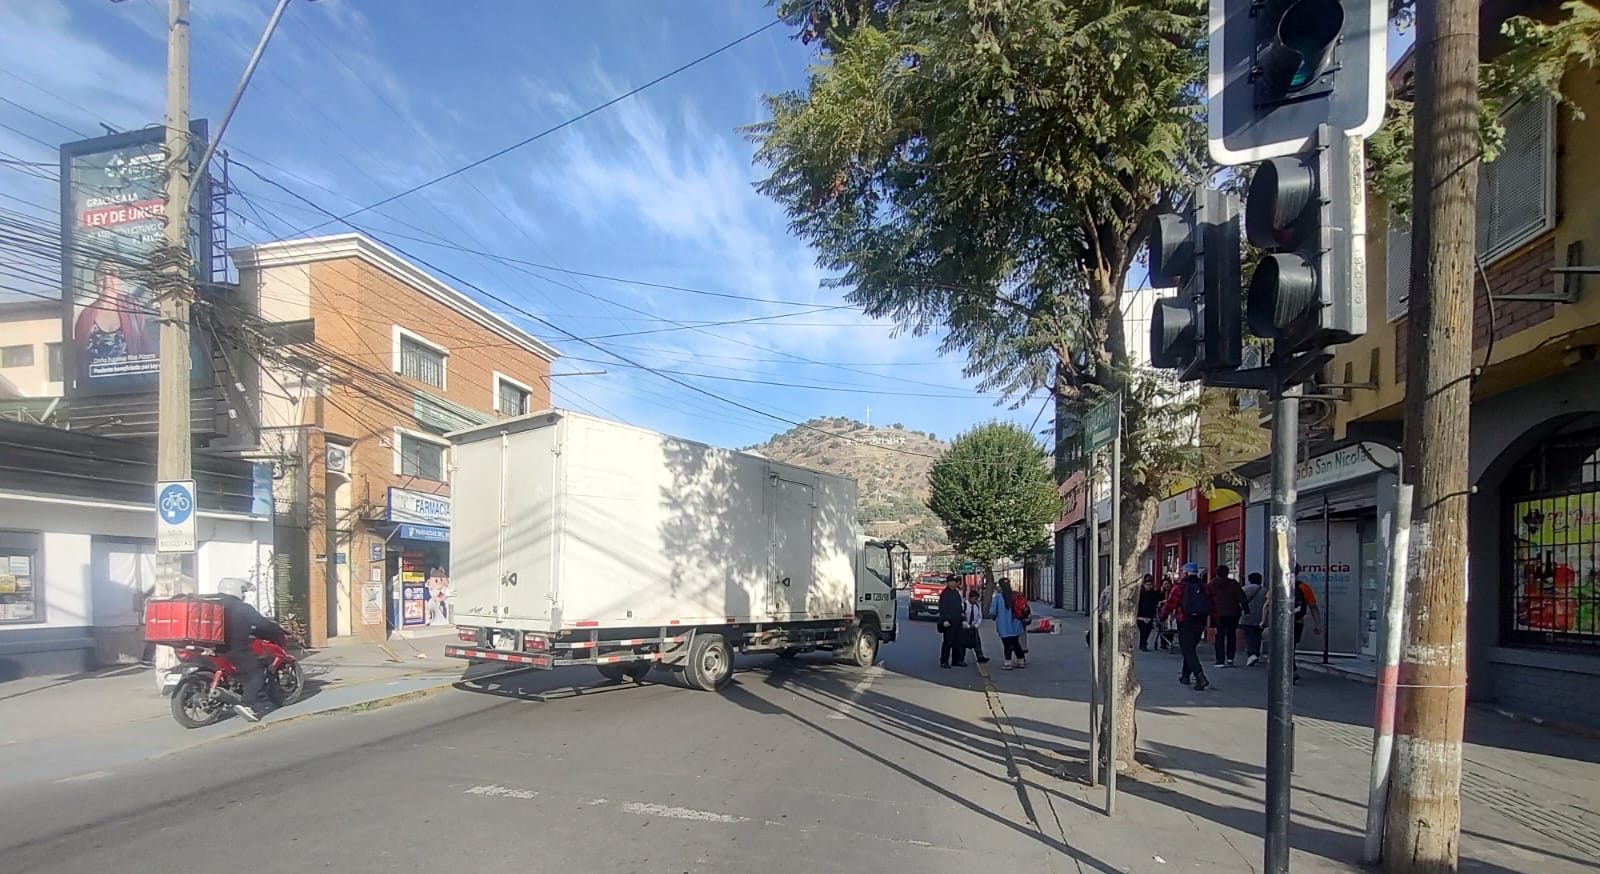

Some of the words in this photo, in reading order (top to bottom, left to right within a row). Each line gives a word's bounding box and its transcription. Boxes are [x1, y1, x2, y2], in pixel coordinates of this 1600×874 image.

[87, 212, 107, 227] LEY
[110, 209, 126, 223] DE
[128, 203, 166, 220] URGEN
[1315, 458, 1333, 475] San
[1334, 444, 1372, 466] Nicola
